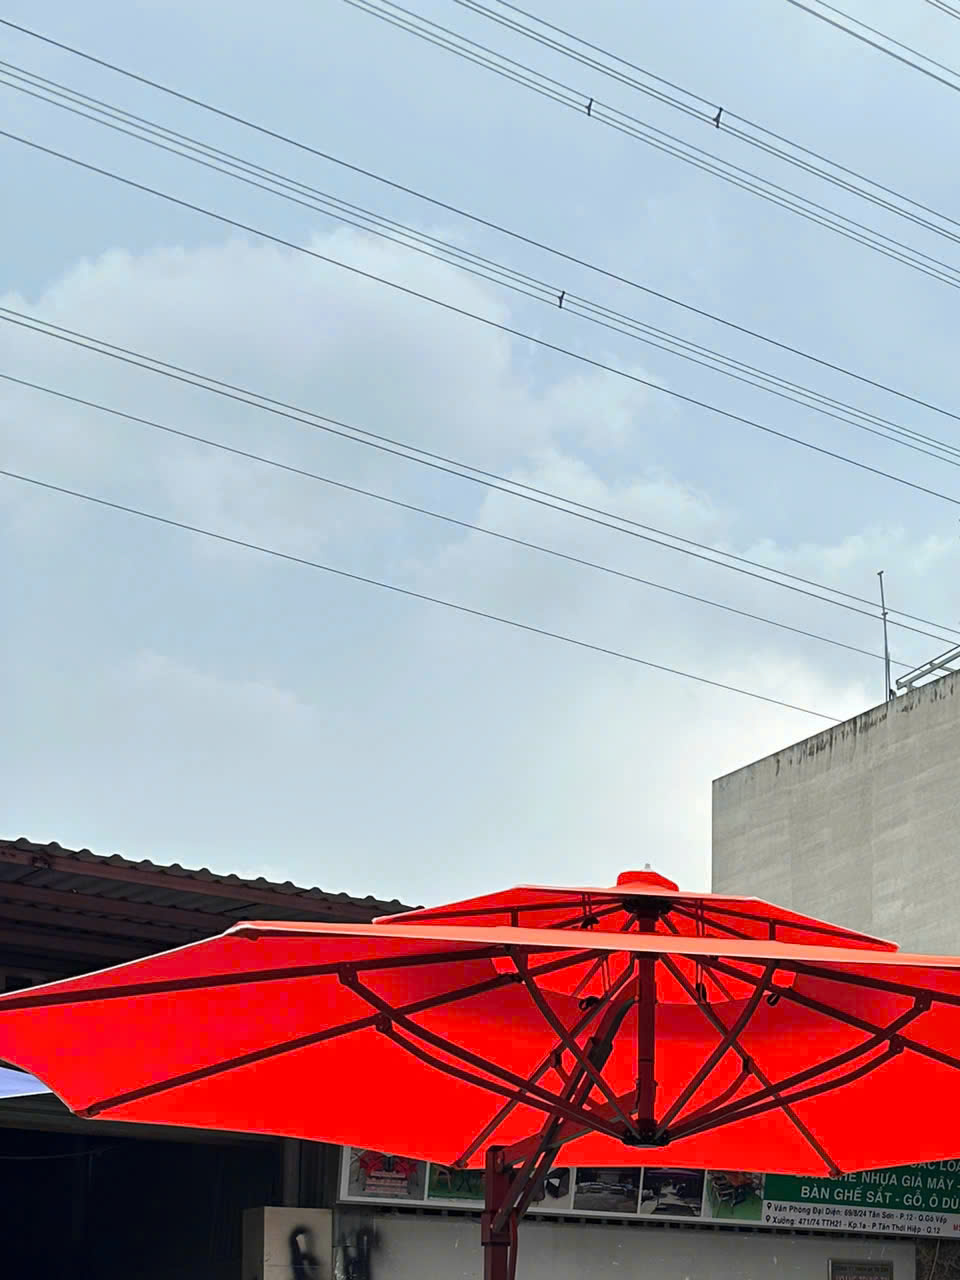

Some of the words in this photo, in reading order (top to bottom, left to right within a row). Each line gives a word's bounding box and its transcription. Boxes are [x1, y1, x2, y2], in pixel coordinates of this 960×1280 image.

[801, 1184, 830, 1199] BÀN
[834, 1186, 863, 1201] GHẾ
[929, 1194, 939, 1208] Ô
